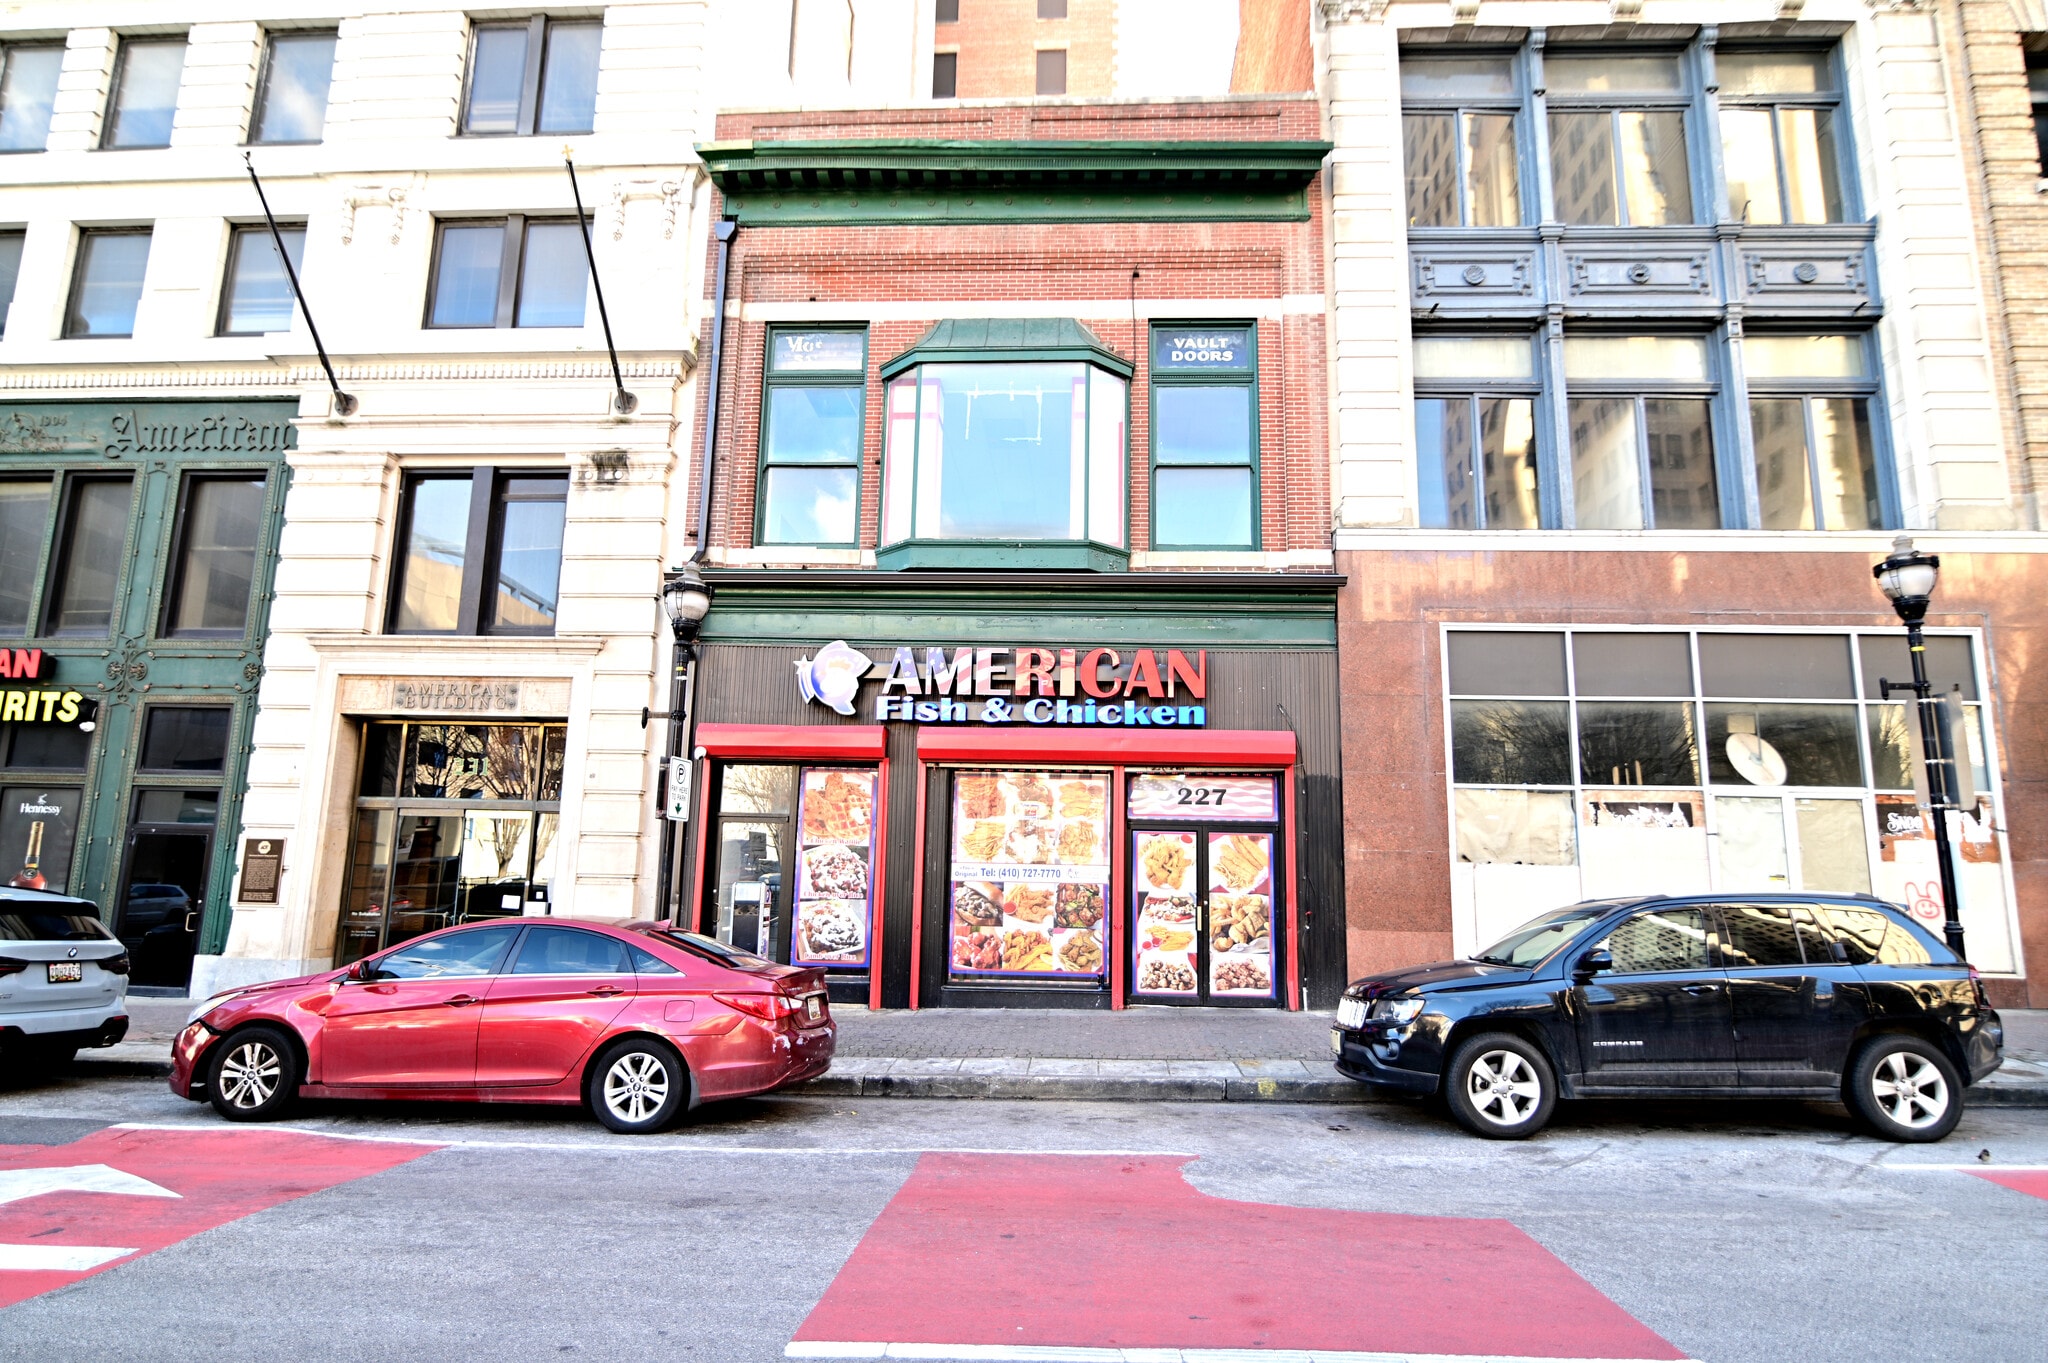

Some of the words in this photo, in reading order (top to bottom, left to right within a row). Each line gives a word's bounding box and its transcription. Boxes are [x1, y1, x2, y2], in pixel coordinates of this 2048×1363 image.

[1173, 337, 1229, 349] VAULT
[1171, 350, 1233, 361] DOORS
[104, 408, 291, 459] American
[881, 646, 1207, 699] AMERICAN
[406, 683, 508, 697] AMERICAN
[0, 691, 84, 723] RITS
[405, 696, 507, 710] BUILDING
[876, 695, 968, 722] Fish
[980, 698, 1013, 723] &
[1023, 698, 1206, 726] Chicken
[452, 757, 489, 776] 231
[1177, 787, 1227, 806] 227
[20, 803, 62, 815] Hennessy
[981, 867, 996, 877] Tel:
[998, 867, 1020, 879] (410)
[1022, 868, 1061, 878] 727-7770
